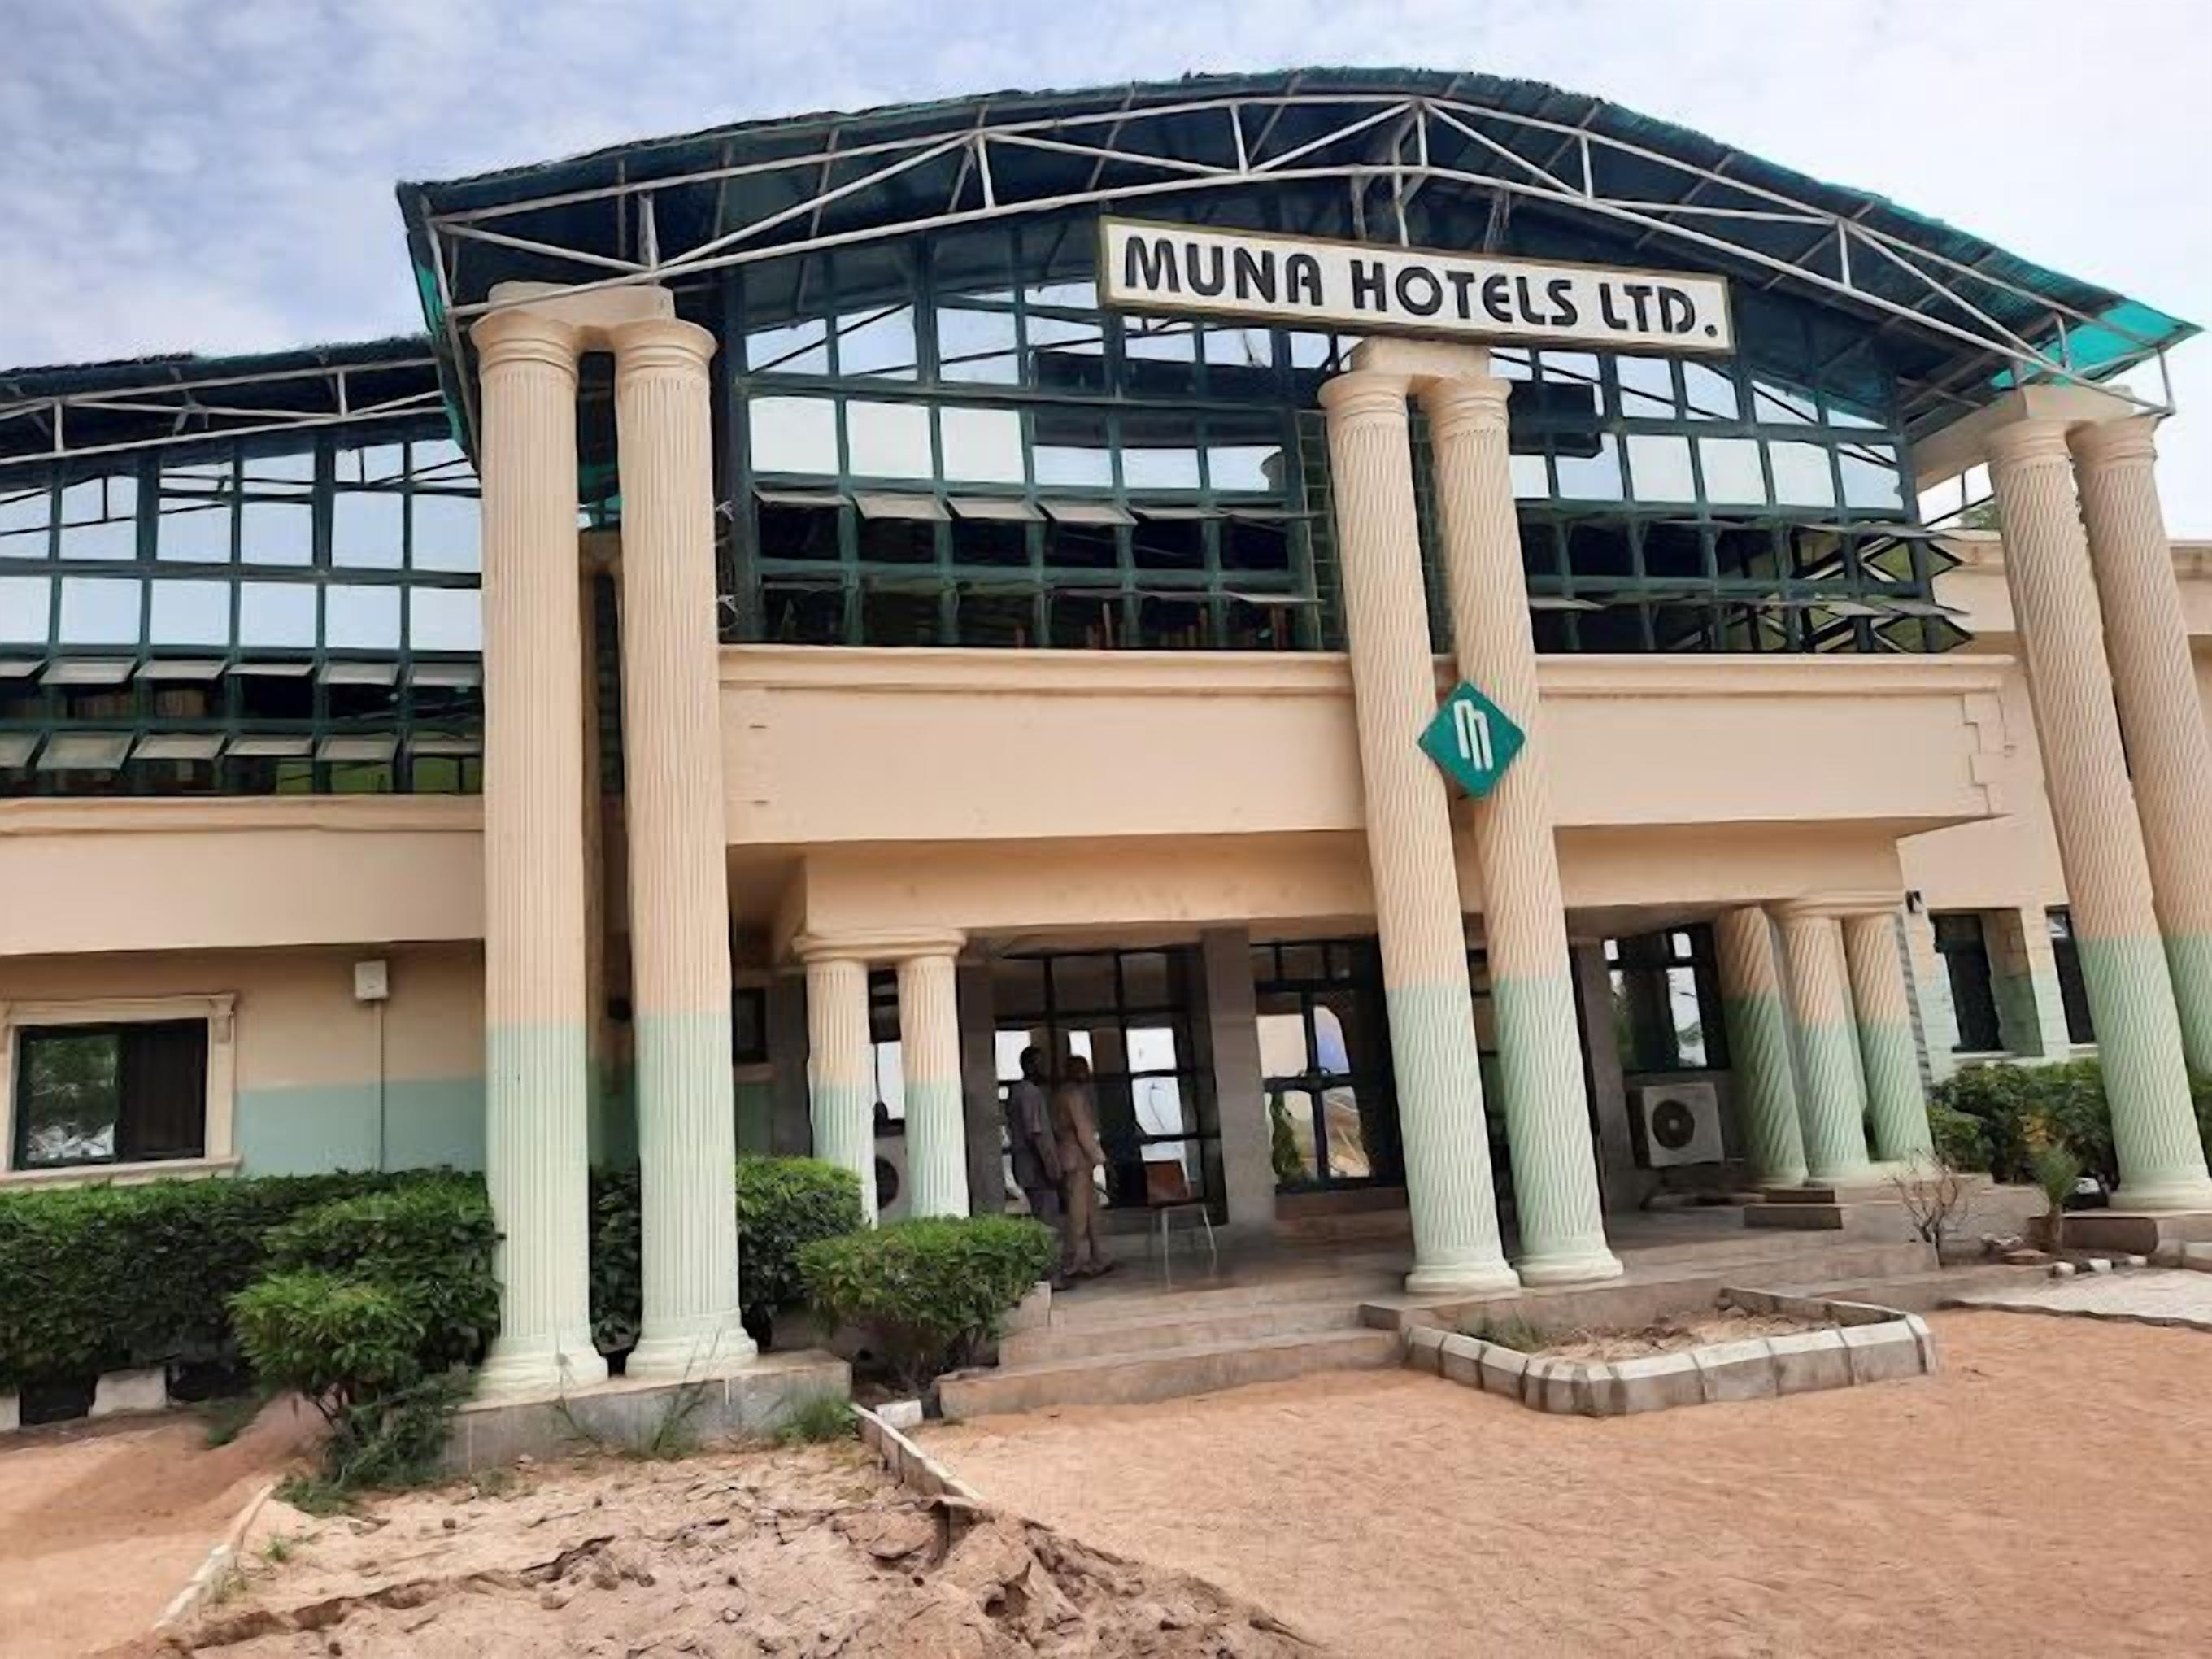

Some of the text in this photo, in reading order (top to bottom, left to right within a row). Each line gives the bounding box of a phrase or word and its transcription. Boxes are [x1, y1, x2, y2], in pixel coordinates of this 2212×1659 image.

[1124, 235, 1718, 337] MUNA HOTELS LTD.
